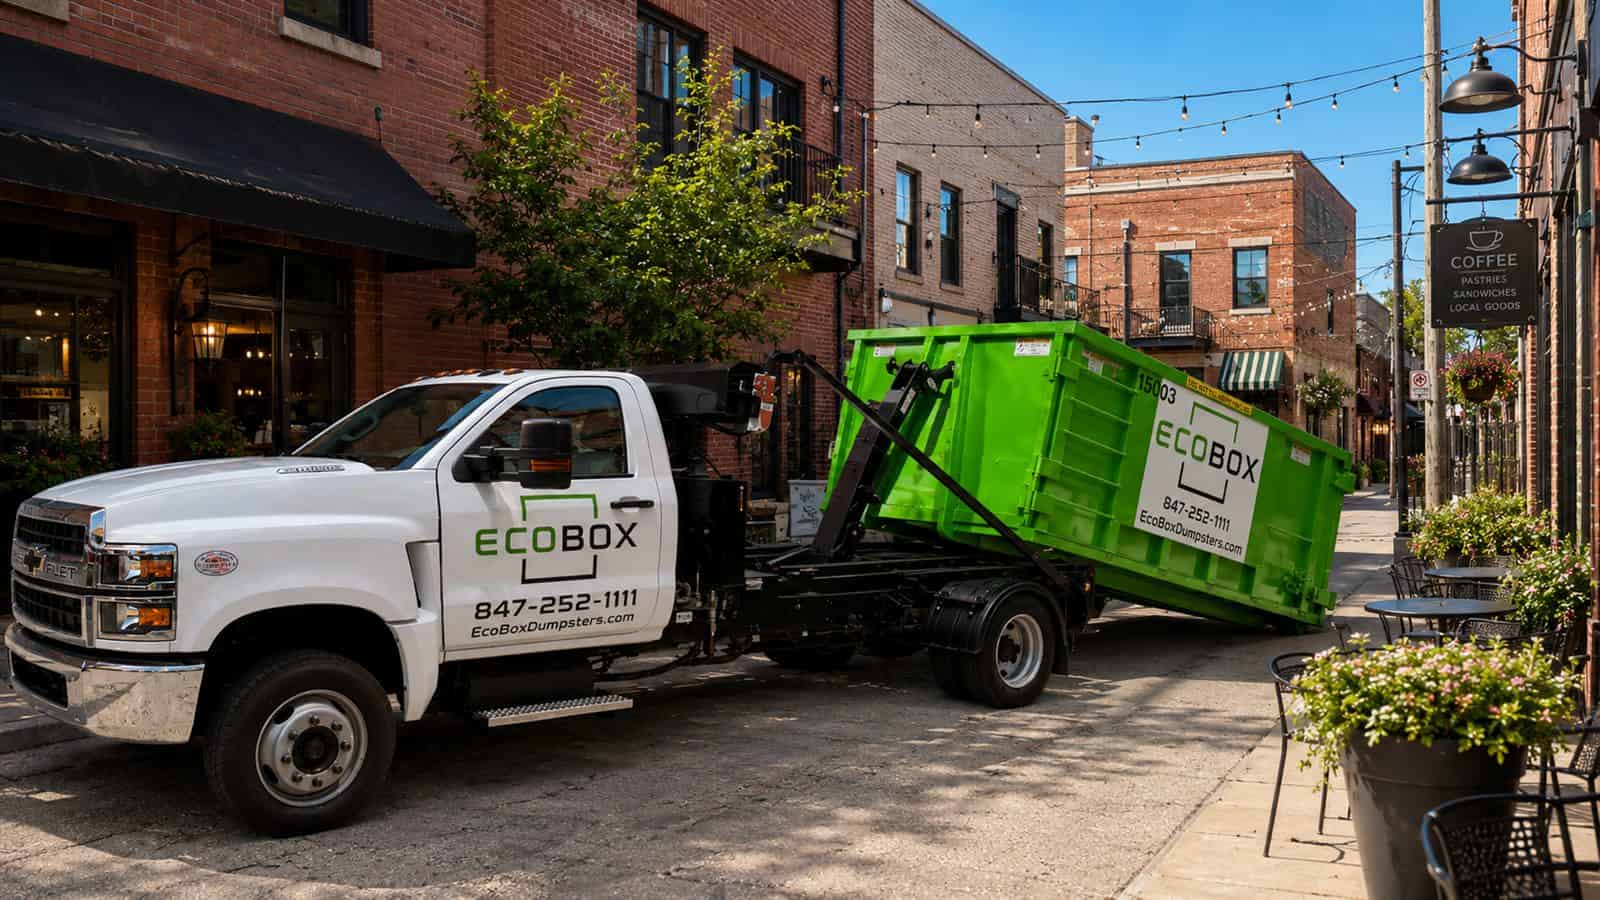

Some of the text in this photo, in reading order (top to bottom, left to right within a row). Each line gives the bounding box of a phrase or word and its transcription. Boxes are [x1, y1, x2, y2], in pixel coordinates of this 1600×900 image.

[1451, 253, 1518, 269] COFFEE
[1453, 288, 1517, 299] SANDWICHES
[1461, 274, 1507, 286] PASTRIES
[1449, 301, 1521, 313] LOCAL GOODS
[1139, 373, 1177, 404] 15003
[1156, 420, 1259, 483] ECOBOX
[1162, 496, 1231, 533] 847-252-1111
[475, 522, 638, 556] ECOBOX
[1139, 509, 1243, 556] EcoBoxDumpsters.com
[474, 589, 638, 620] 847-252-1111
[471, 613, 635, 638] EcoBoxDumpsters.com
